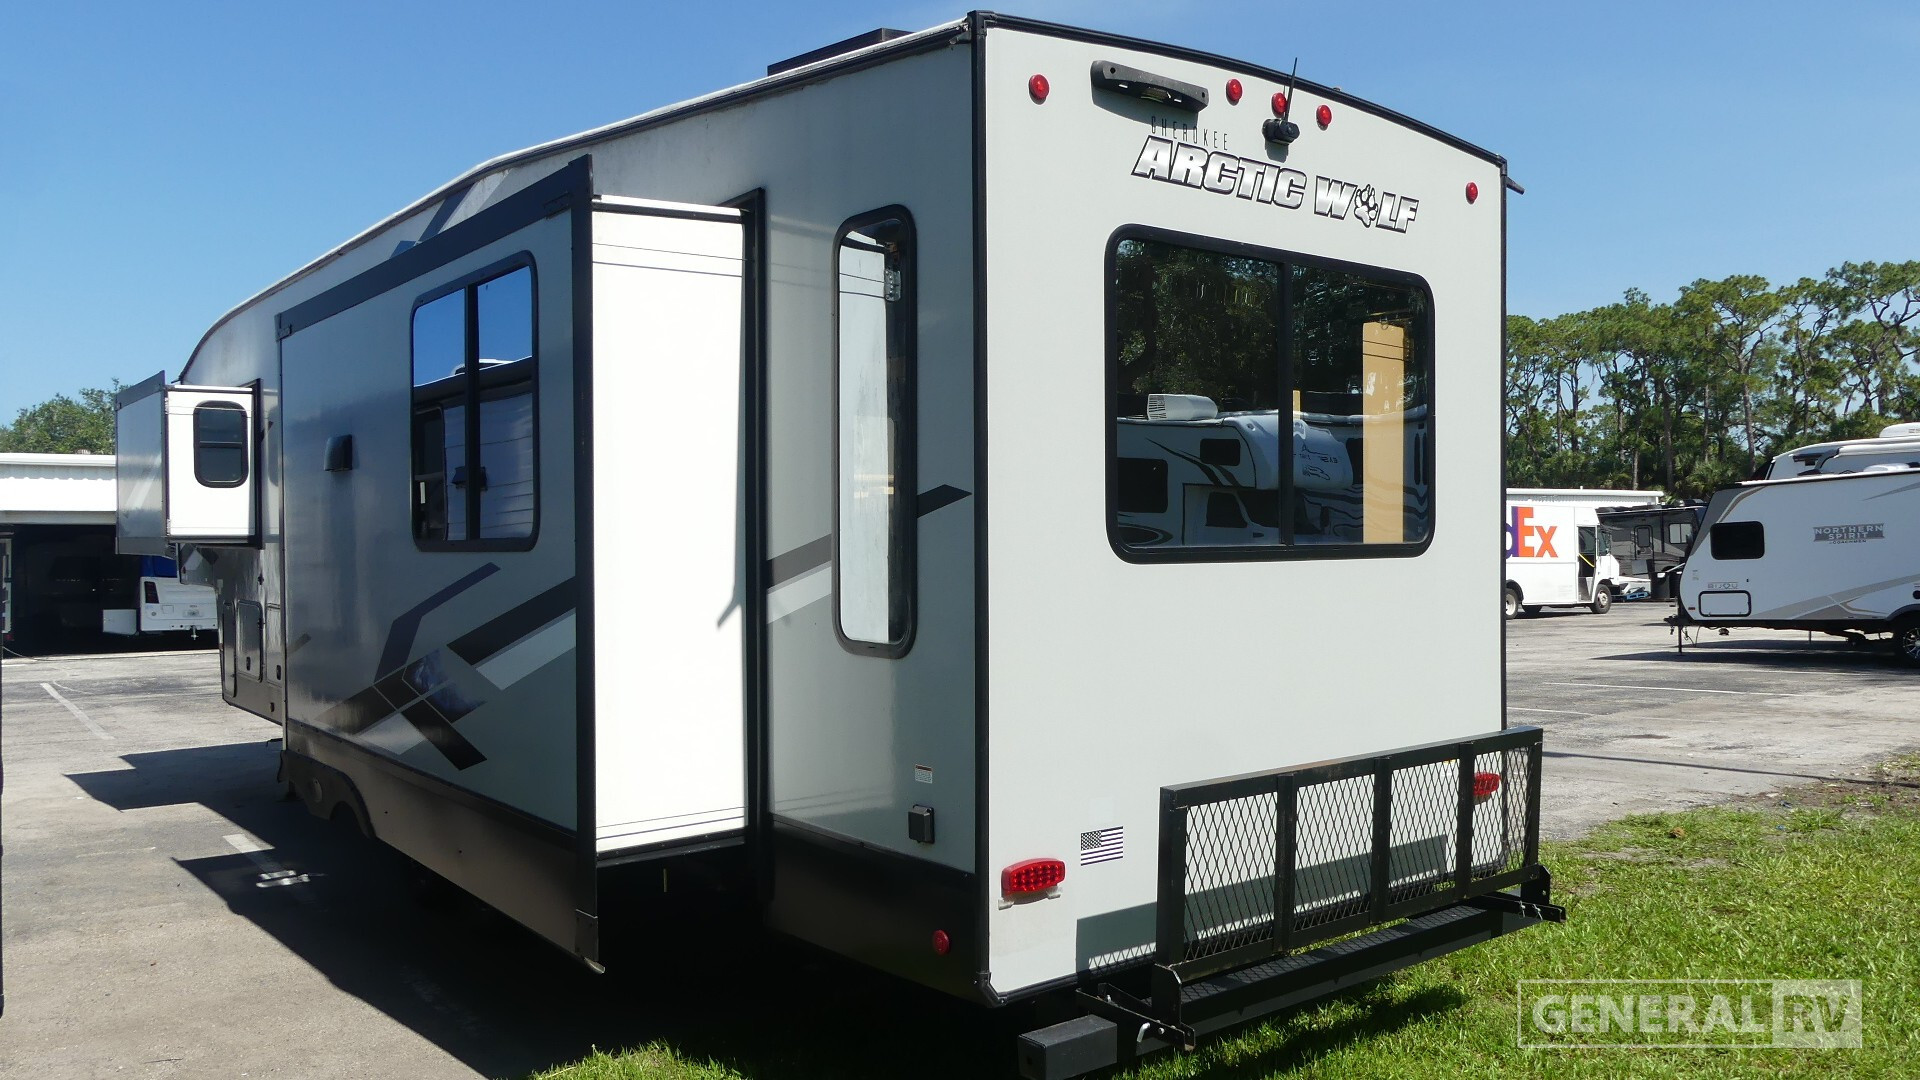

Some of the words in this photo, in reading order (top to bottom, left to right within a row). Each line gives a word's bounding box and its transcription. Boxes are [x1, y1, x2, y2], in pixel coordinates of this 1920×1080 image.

[1151, 115, 1228, 151] CHEROKEE
[1131, 134, 1307, 210] ARCTIC
[1505, 505, 1559, 559] dEx
[1815, 525, 1883, 535] NORTHERN
[1828, 532, 1868, 540] SPIRIT
